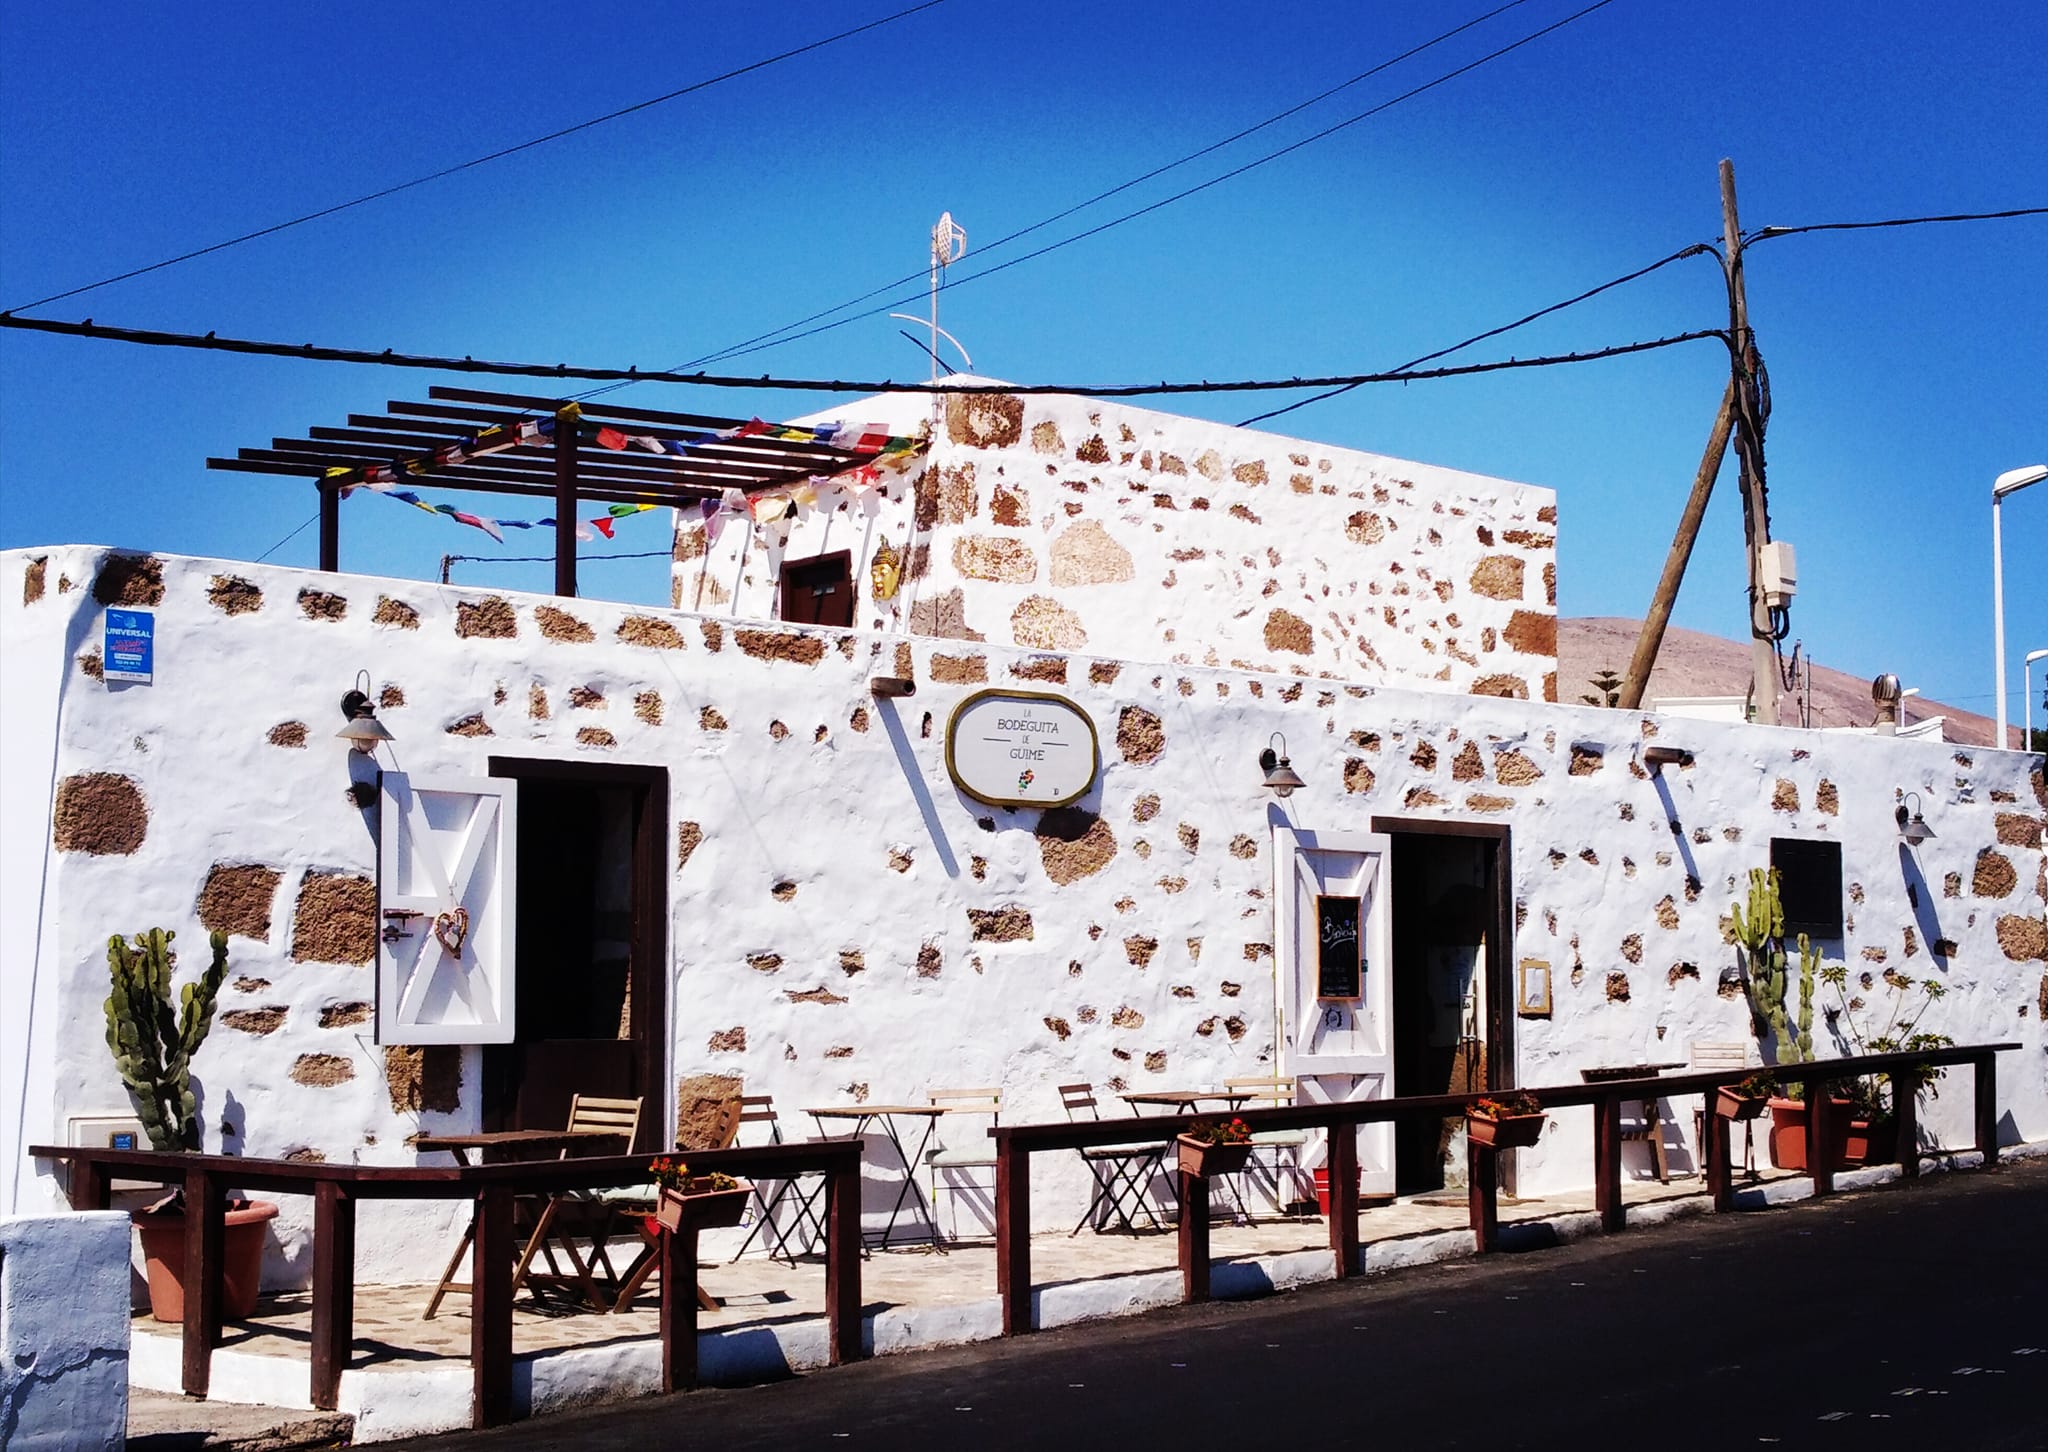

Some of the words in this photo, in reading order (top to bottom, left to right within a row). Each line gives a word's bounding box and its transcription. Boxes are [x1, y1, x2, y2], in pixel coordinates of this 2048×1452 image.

[106, 627, 152, 638] UNIVERSAL
[1024, 709, 1032, 718] LA
[998, 719, 1059, 734] BODEGUITA
[1022, 735, 1030, 745] DE
[1010, 748, 1045, 761] GUIME
